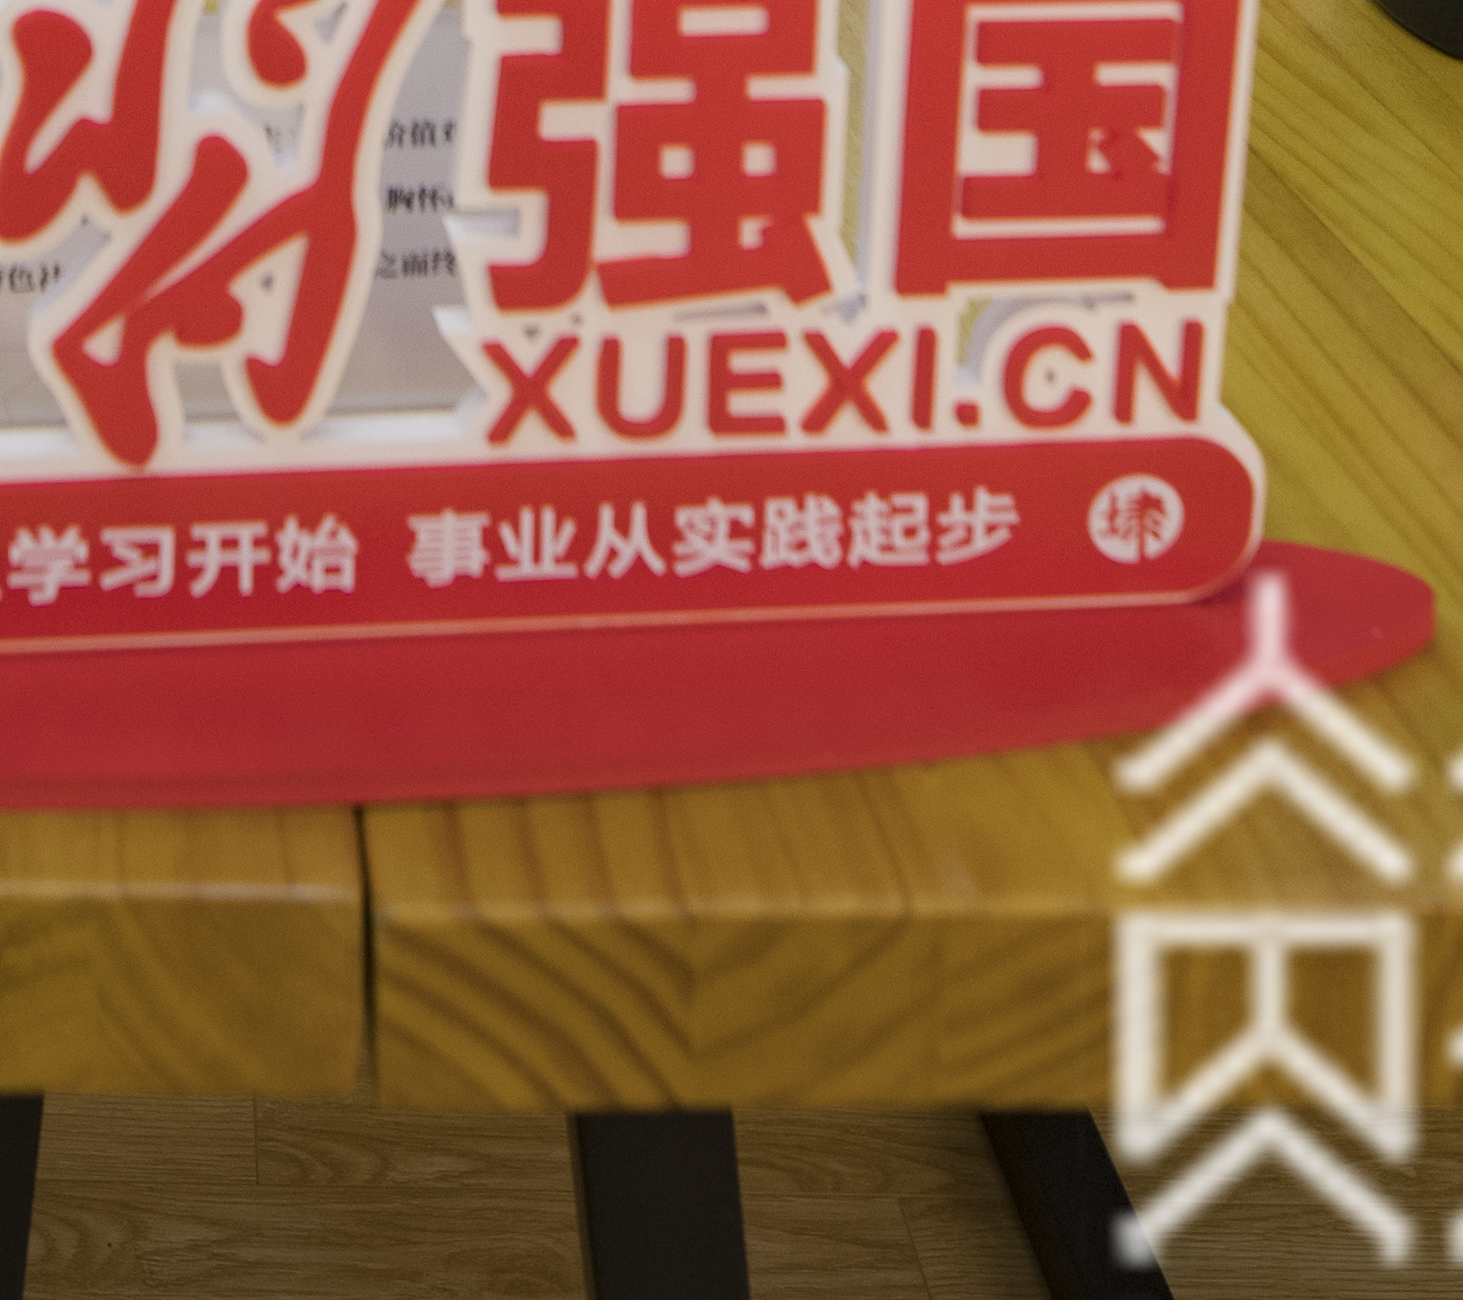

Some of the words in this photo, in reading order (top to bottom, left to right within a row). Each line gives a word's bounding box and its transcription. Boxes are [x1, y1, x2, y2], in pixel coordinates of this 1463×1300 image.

[482, 318, 1207, 448] XUEXI.CN
[406, 486, 1019, 588] 事业从实践起步
